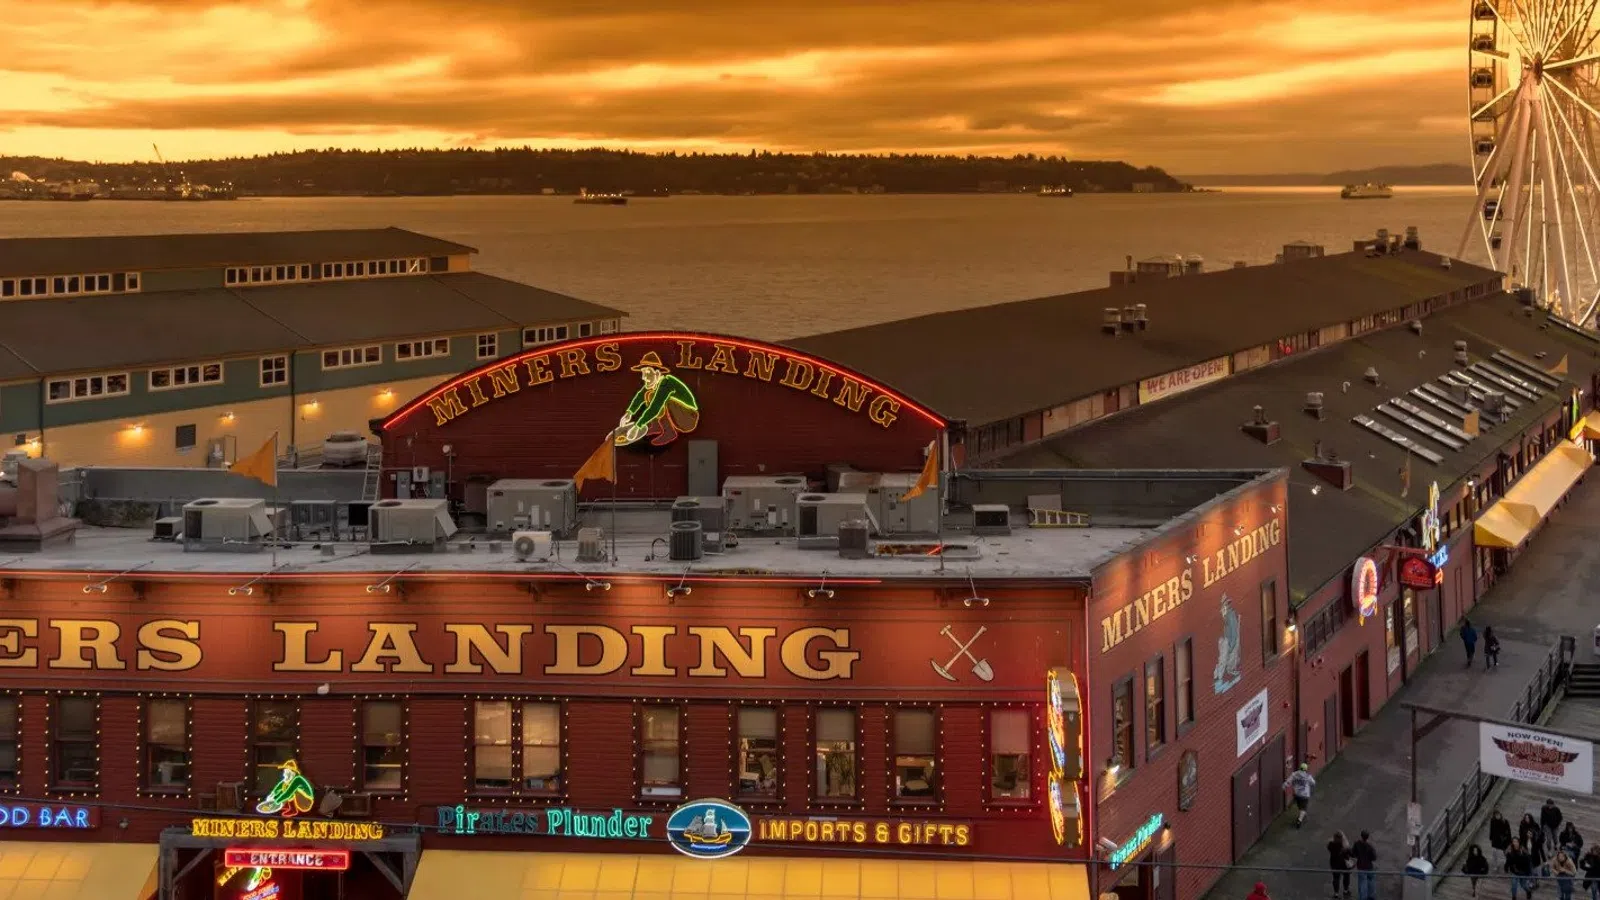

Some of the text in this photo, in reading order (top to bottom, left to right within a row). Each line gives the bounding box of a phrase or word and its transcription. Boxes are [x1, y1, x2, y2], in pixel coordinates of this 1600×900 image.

[426, 339, 901, 429] MINERS LANDING
[1147, 360, 1224, 394] WE ARE OPEN!
[1101, 517, 1281, 654] MINERS LANDING
[0, 617, 861, 680] ERS LANDING
[1507, 732, 1564, 747] NOW OPEN!
[40, 807, 90, 828] BAR
[192, 818, 384, 840] MINERS LANDING
[437, 803, 653, 838] Pirates Plunder
[758, 818, 970, 846] IMPORTS & GIFTS
[251, 853, 323, 867] ENTRANCE
